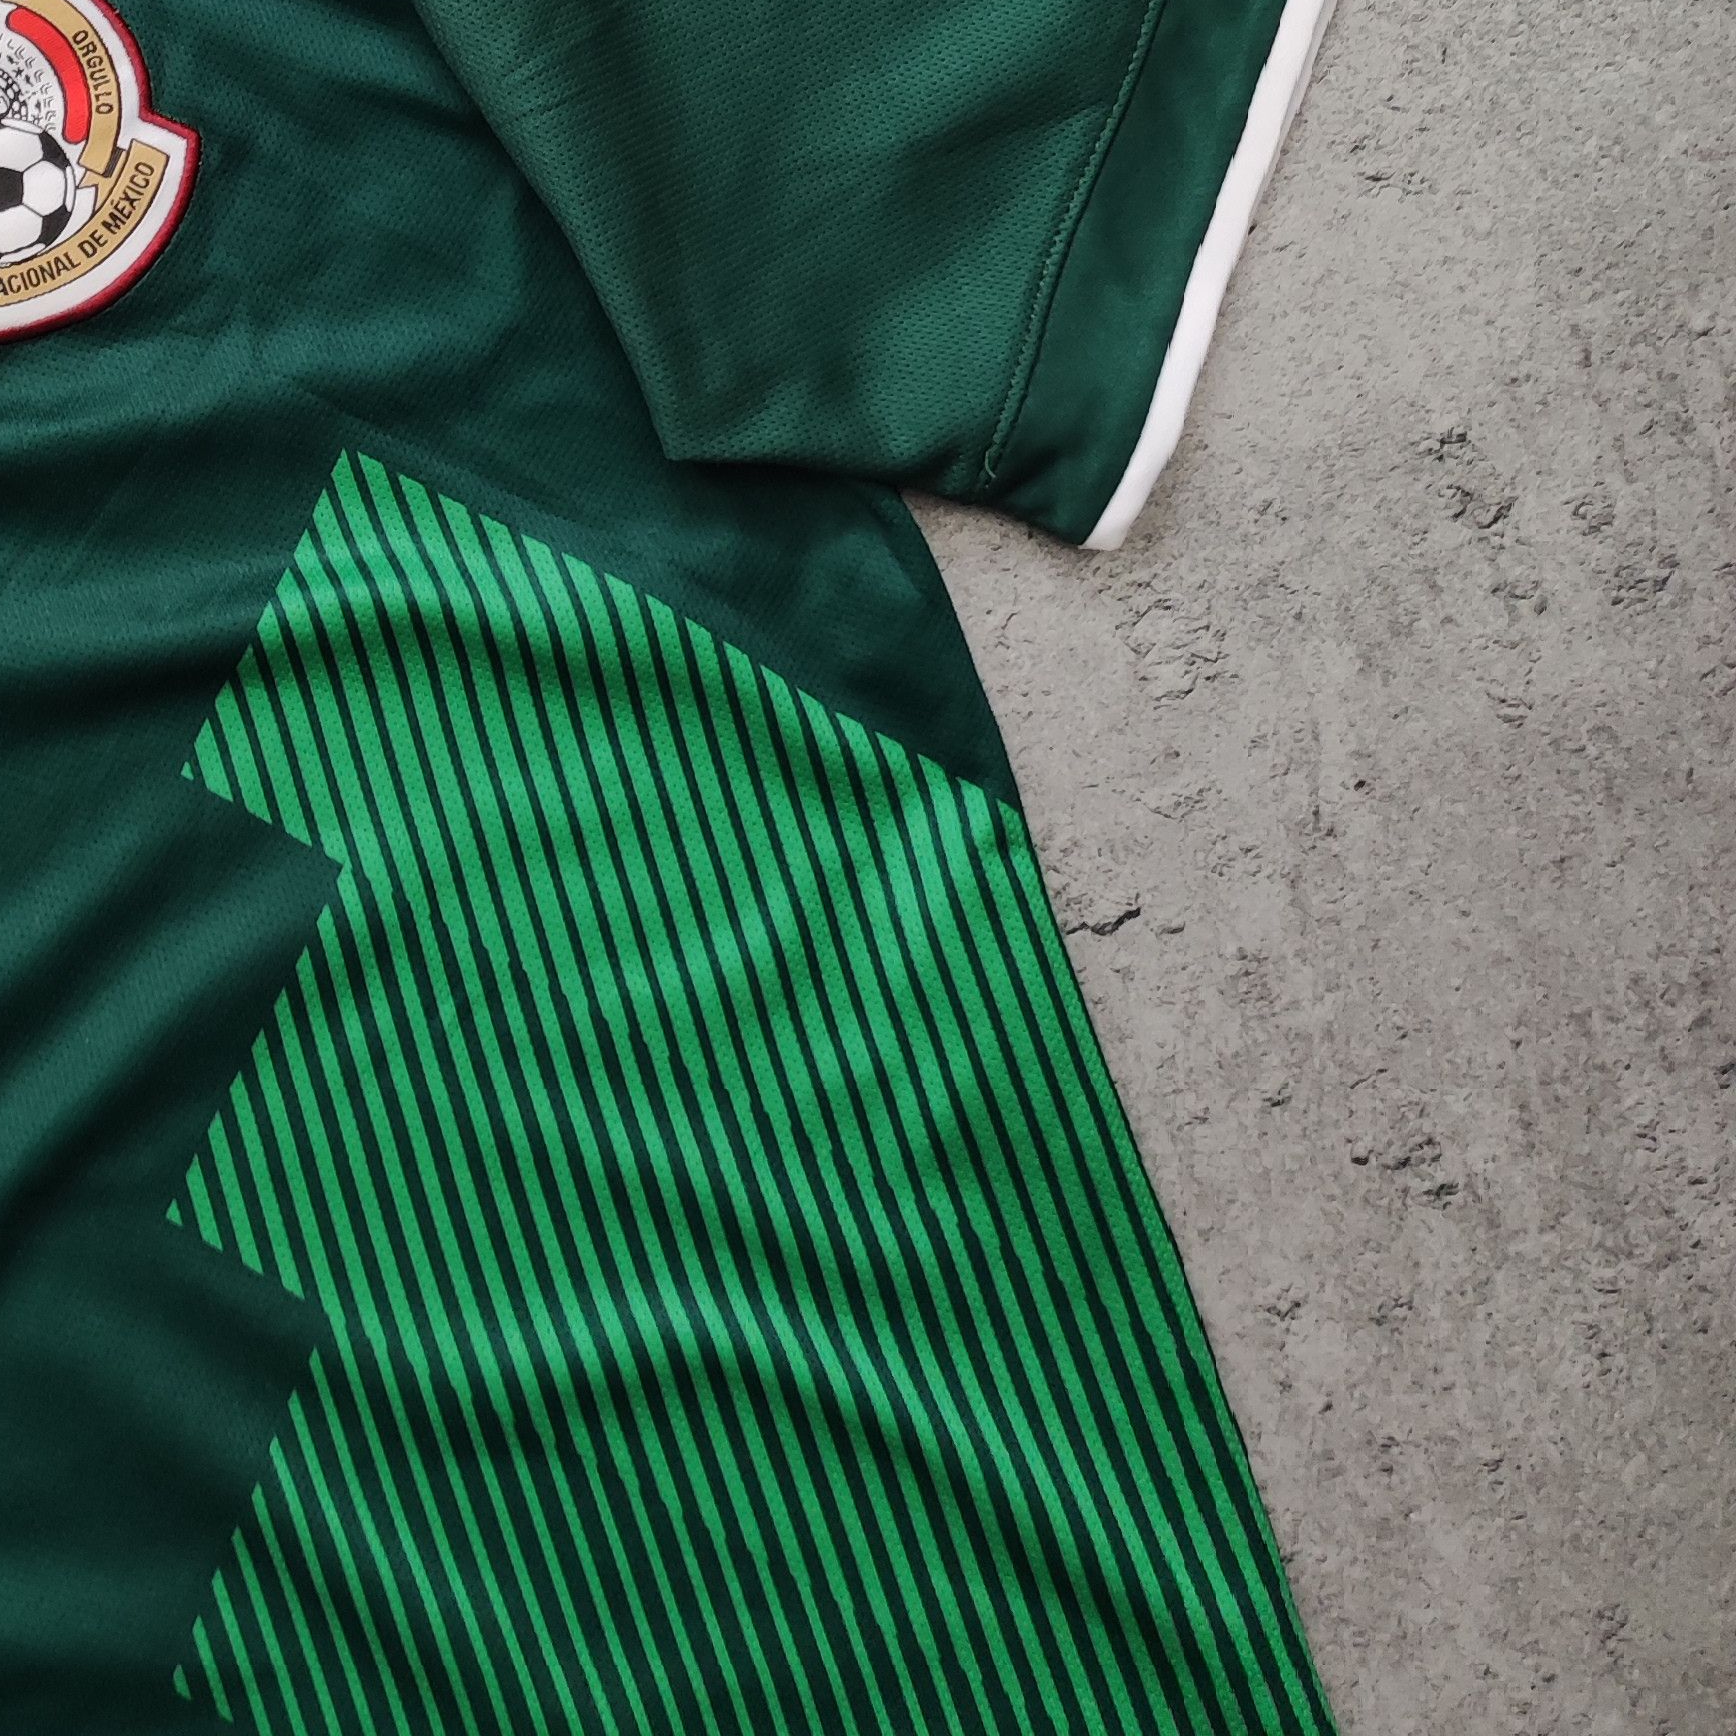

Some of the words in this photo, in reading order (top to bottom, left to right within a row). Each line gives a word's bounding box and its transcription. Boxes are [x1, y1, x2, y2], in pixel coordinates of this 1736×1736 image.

[72, 29, 114, 115] ORGULLO
[77, 229, 108, 258] DE
[101, 161, 155, 234] MÉXICO
